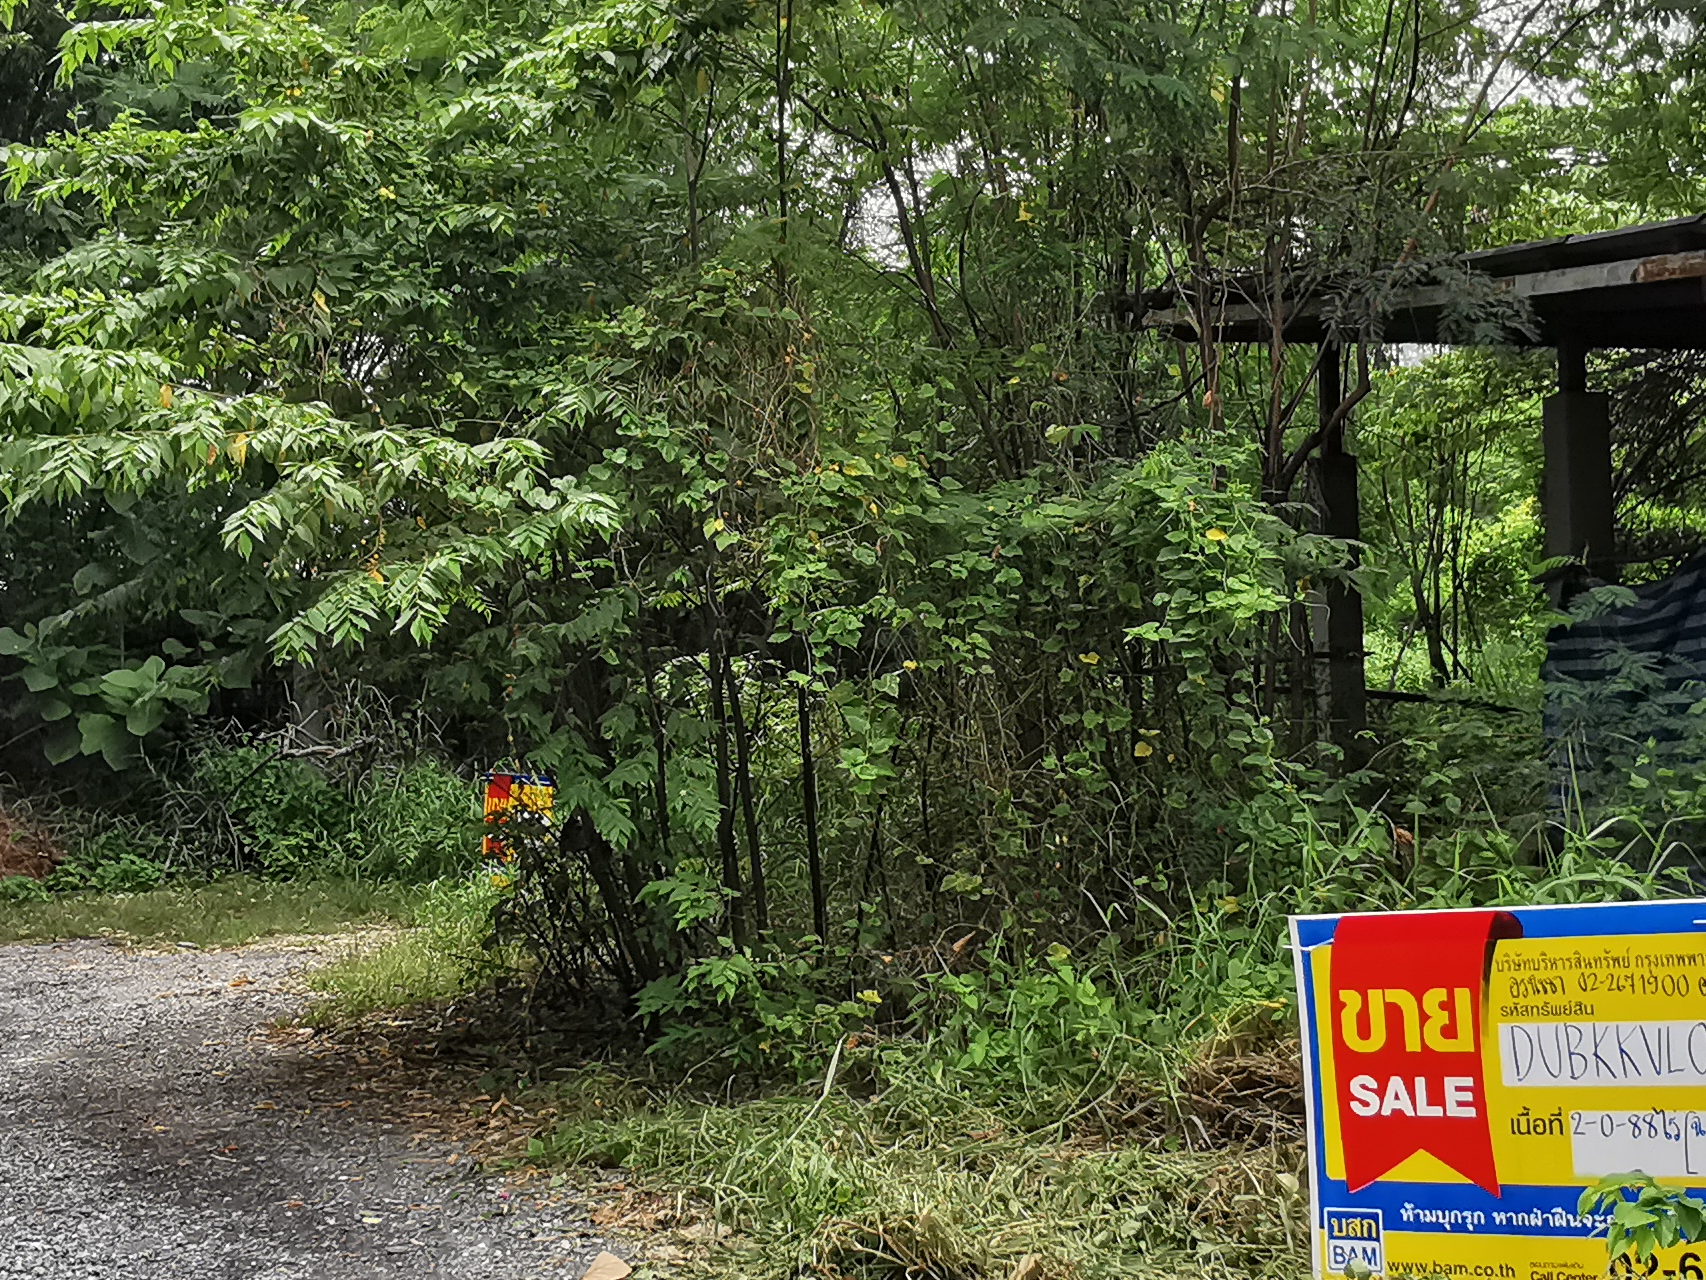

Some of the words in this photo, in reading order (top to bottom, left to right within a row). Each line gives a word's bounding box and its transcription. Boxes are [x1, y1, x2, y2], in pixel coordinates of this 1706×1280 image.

[1495, 946, 1631, 973] บริษัทบริหารสินทรัพย์
[1338, 987, 1475, 1053] ขาย
[1499, 999, 1595, 1018] รหัสทรัพย์สิน
[1349, 1074, 1477, 1118] SALE
[1509, 1106, 1564, 1136] เนื้อที่
[1331, 1217, 1378, 1238] บสก
[1399, 1201, 1486, 1232] ห้ามบุกรุก
[1332, 1244, 1378, 1267] BAM
[1386, 1260, 1516, 1280] www.bam.co.th
